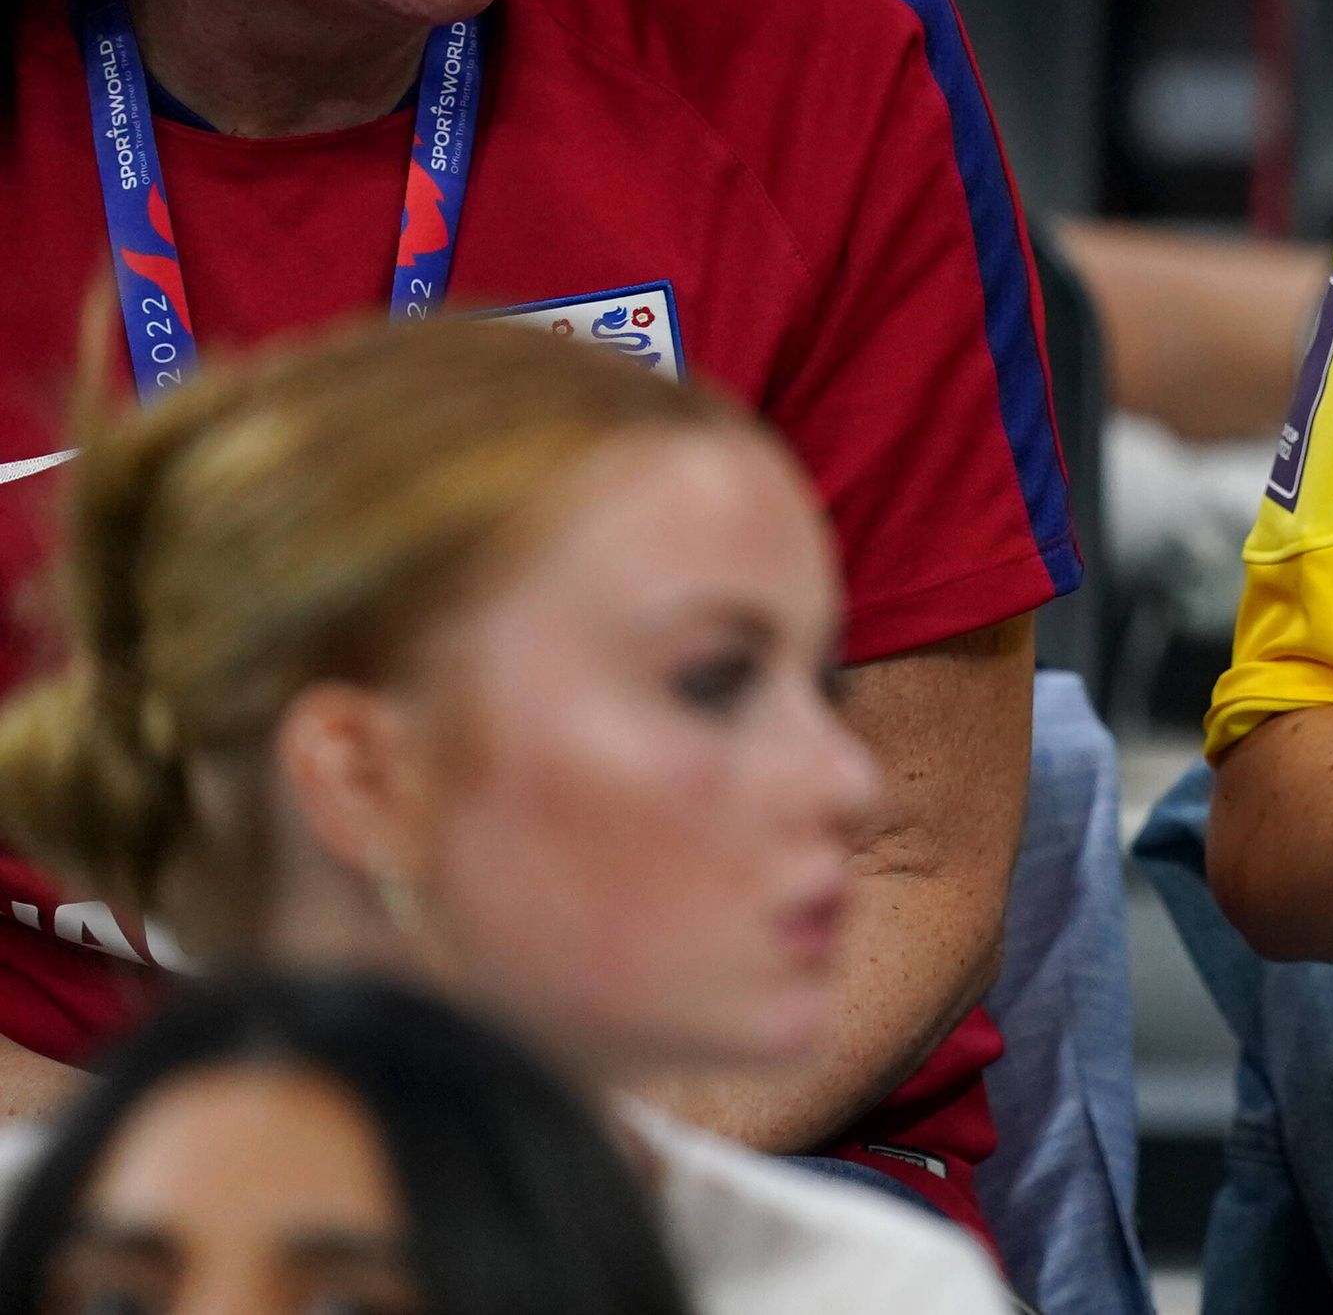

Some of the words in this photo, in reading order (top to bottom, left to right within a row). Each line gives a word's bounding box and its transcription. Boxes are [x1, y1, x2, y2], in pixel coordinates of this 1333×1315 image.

[126, 84, 139, 118] Partner
[460, 71, 473, 107] Partner
[132, 121, 144, 151] Travel
[456, 109, 467, 136] Travel
[138, 150, 150, 185] Official
[451, 139, 463, 174] Official
[141, 294, 182, 388] 2022
